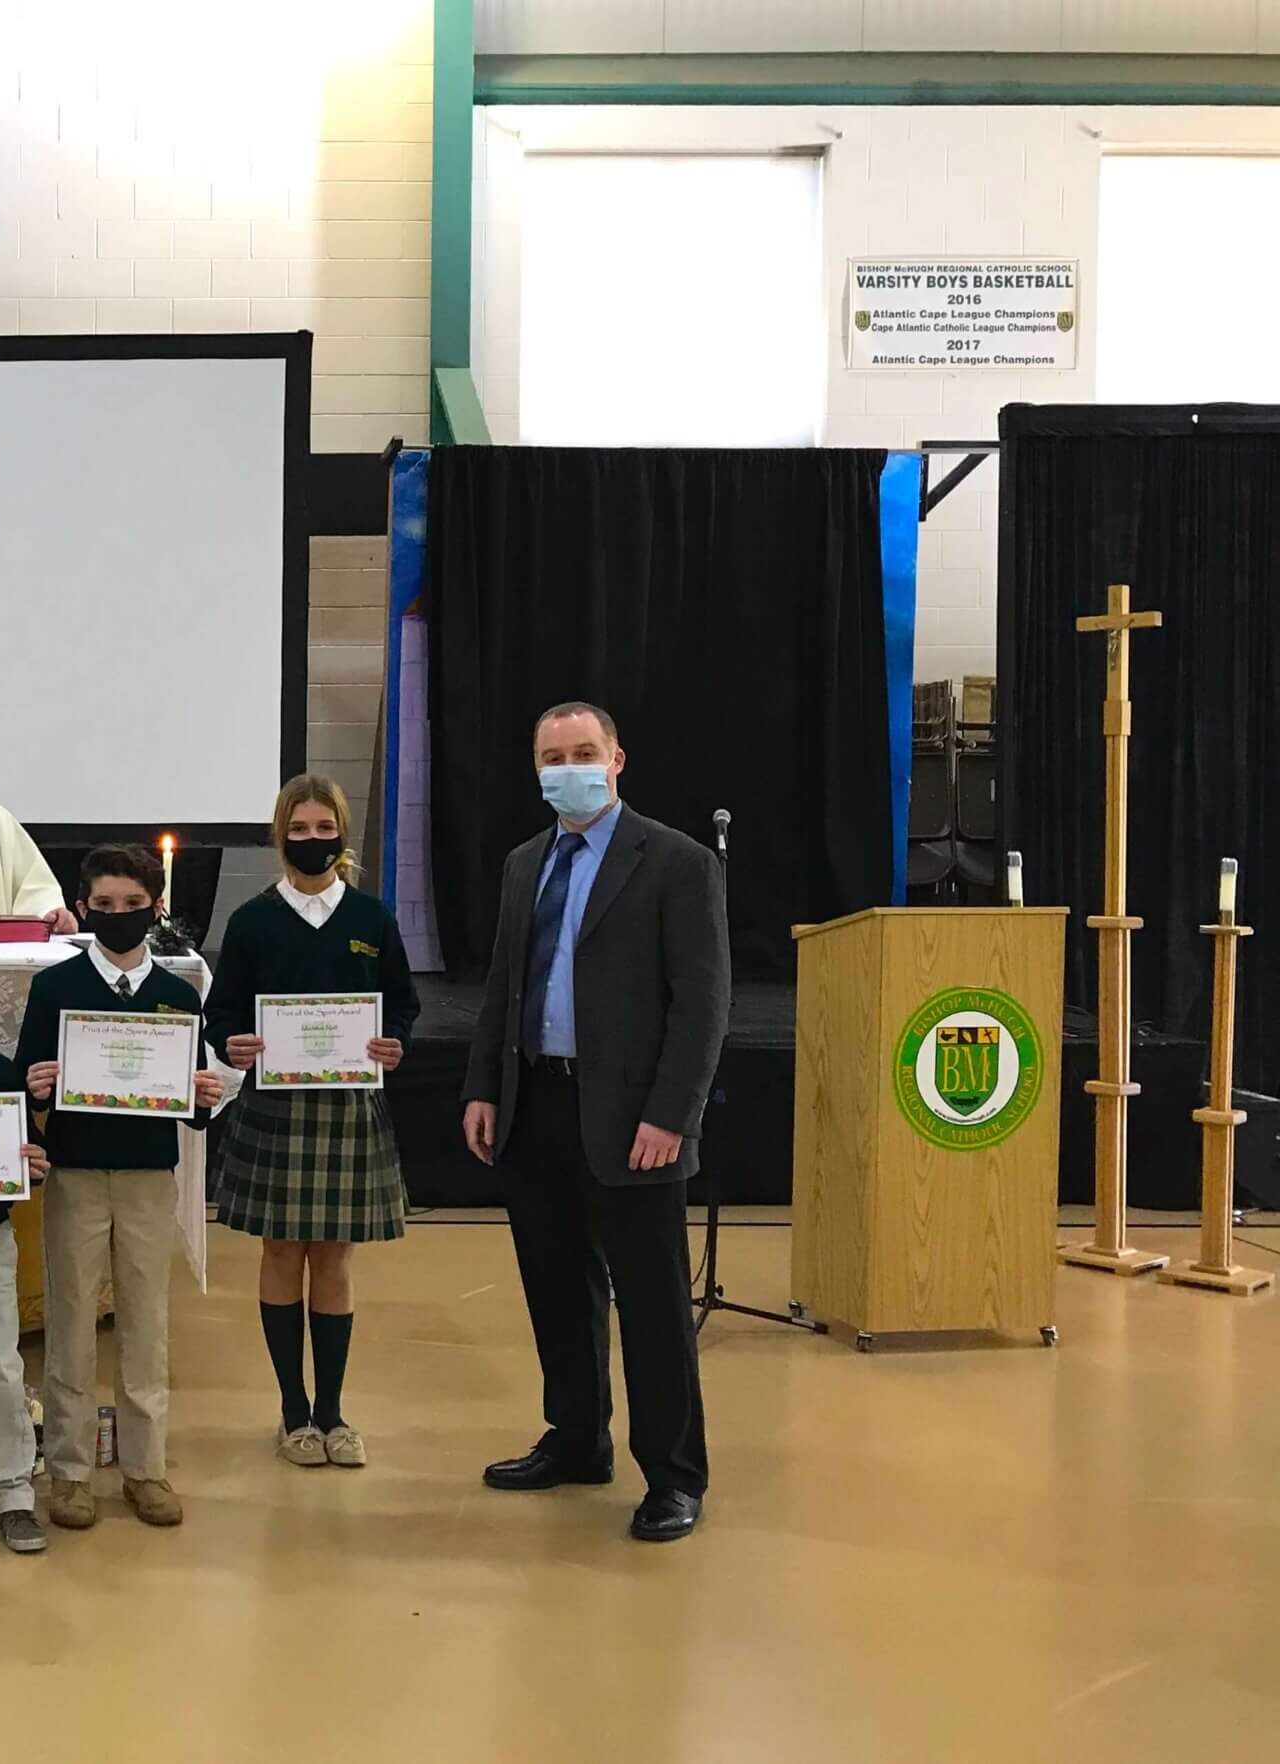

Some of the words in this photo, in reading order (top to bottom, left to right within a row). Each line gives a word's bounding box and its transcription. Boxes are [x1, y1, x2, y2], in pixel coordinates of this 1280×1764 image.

[857, 275, 921, 288] VARSITY
[927, 275, 968, 288] BOYS
[973, 275, 1073, 288] BASKETBALL
[947, 294, 981, 305] 2016
[873, 310, 915, 318] Atlantic
[920, 310, 946, 320] Cape
[951, 310, 990, 320] League
[995, 310, 1055, 320] Champions
[872, 324, 893, 332] Cape
[897, 324, 930, 332] Atlantic
[934, 324, 969, 332] Catholic
[973, 324, 1005, 332] League
[1008, 324, 1056, 332] Champions
[947, 340, 980, 350] 2017
[872, 356, 915, 364] Atlantic
[919, 356, 946, 365] Cape
[950, 356, 989, 365] League
[994, 356, 1054, 365] Champions
[304, 1008, 314, 1016] the
[337, 1008, 360, 1016] Award
[112, 1025, 122, 1033] the
[149, 1028, 175, 1037] Award
